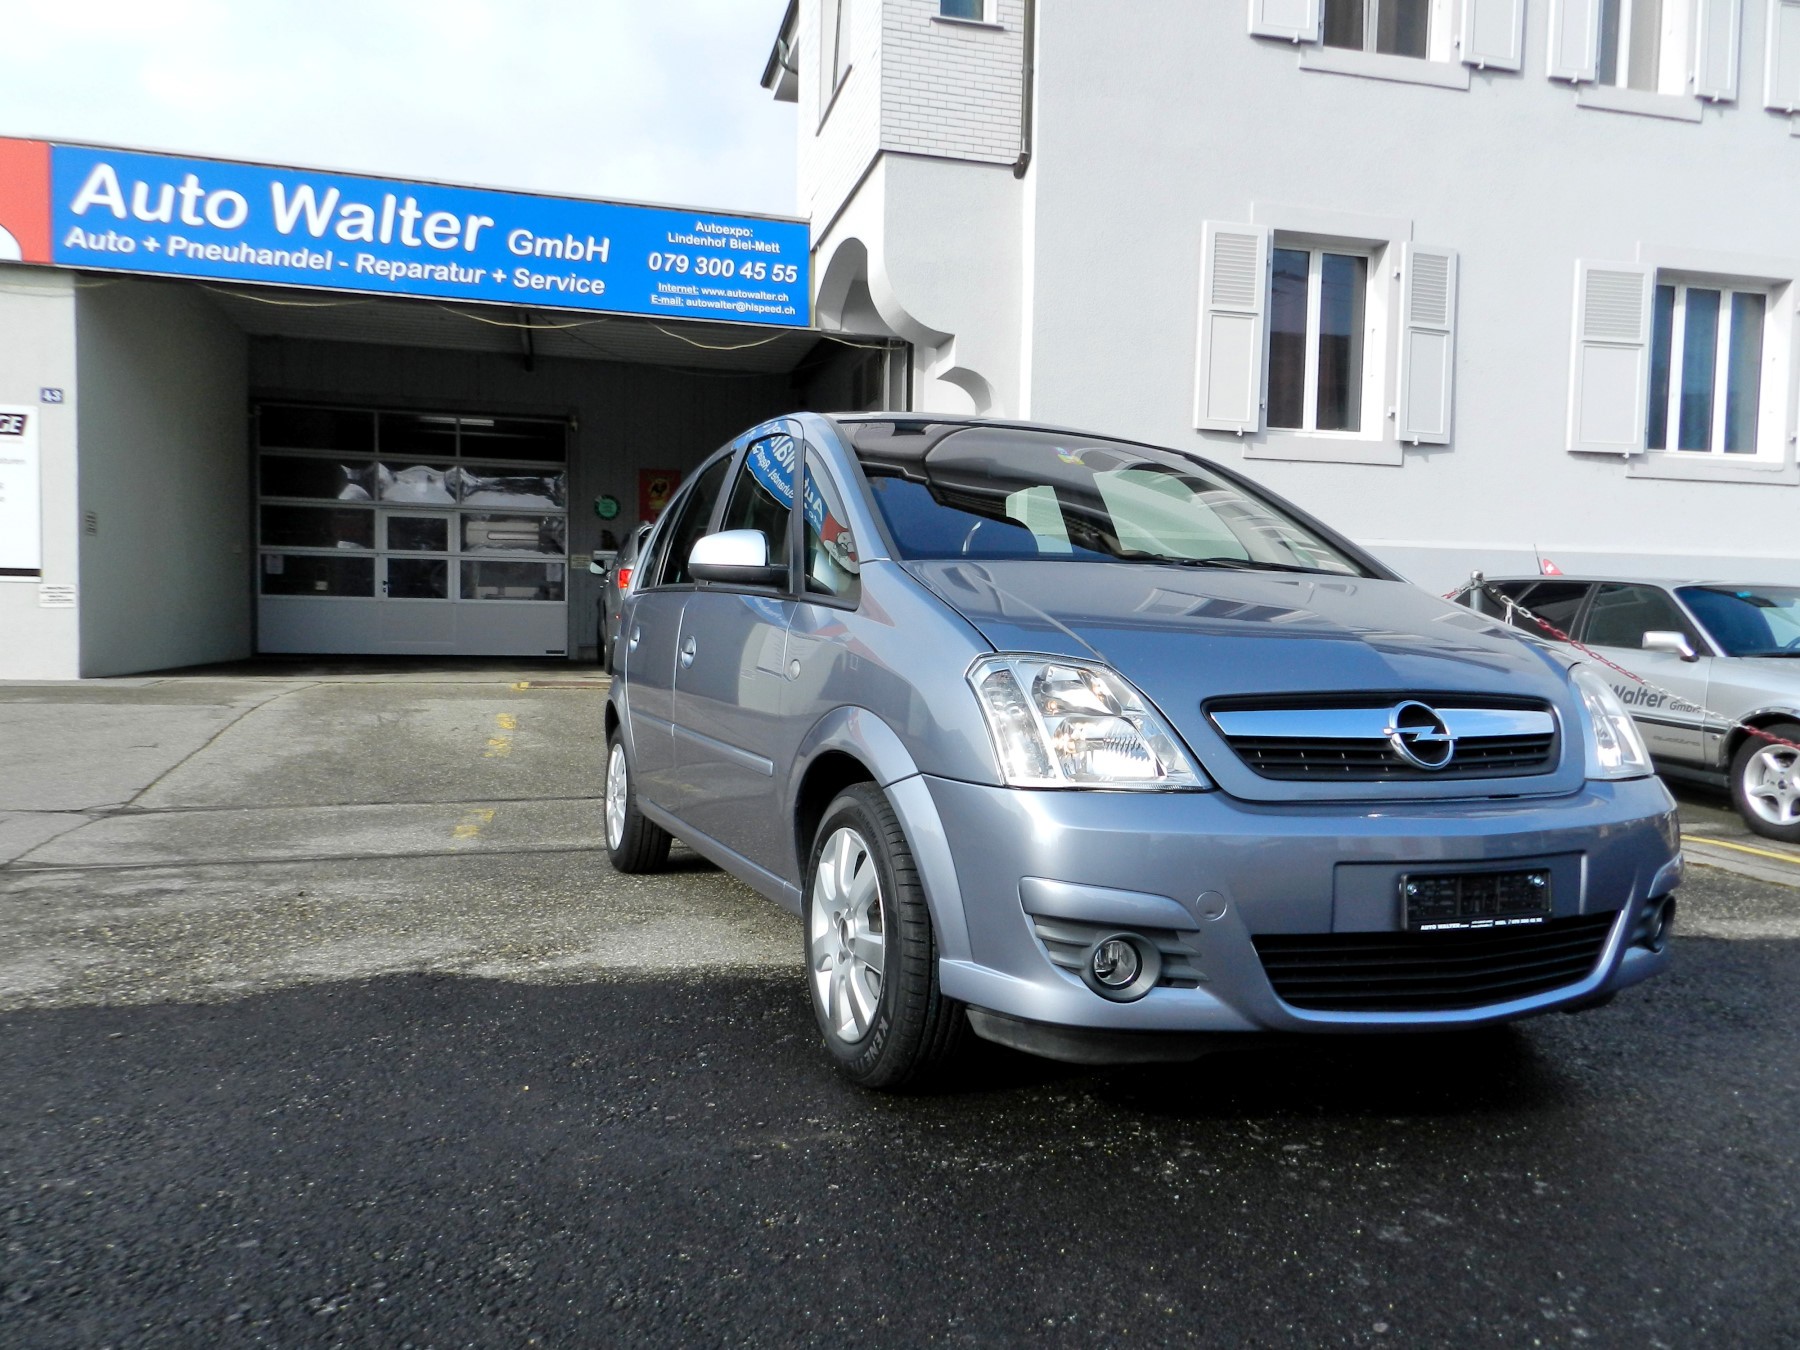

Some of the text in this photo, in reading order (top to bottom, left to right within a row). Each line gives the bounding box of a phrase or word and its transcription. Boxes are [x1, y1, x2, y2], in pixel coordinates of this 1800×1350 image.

[70, 162, 610, 263] Auto Walter GmbH
[695, 221, 754, 238] Autoexpo:
[667, 232, 781, 254] Lindenhof Biel-Mett
[64, 226, 136, 254] Auto
[143, 237, 161, 254] +
[167, 235, 332, 271] Pneuhandel
[355, 252, 486, 284] Reparatur
[492, 269, 507, 283] +
[513, 267, 606, 295] Service
[648, 252, 798, 283] 079 300 45 55
[658, 282, 789, 302] Internet: www.autowalter.ch
[650, 294, 796, 315] E-mail: autowalter@hispeed.ch
